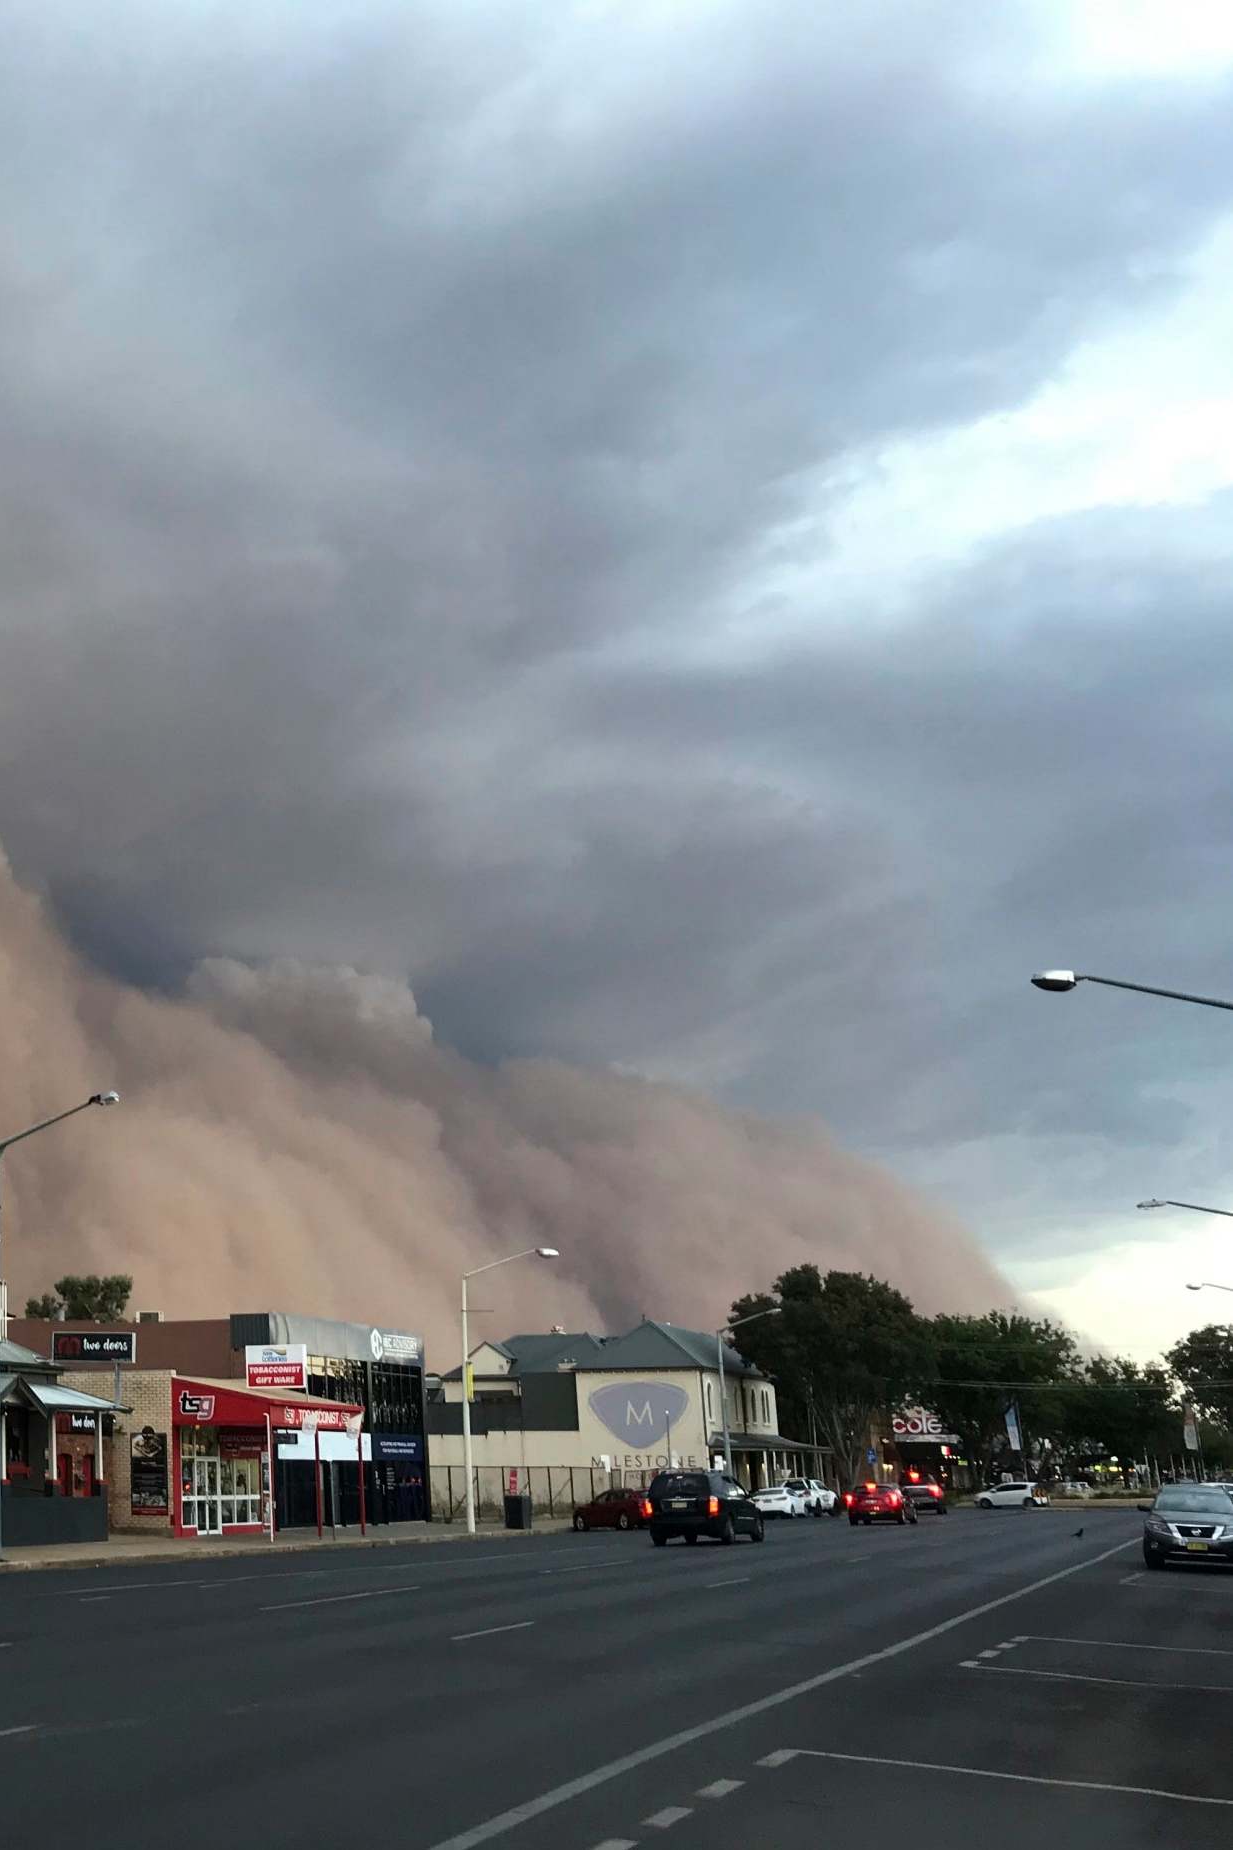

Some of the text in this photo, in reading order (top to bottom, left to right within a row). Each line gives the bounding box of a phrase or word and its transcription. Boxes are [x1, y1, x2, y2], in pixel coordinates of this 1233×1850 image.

[83, 1338, 128, 1351] two doors
[249, 1366, 301, 1374] TOBACCONIST
[273, 1376, 295, 1384] WARE
[179, 1390, 215, 1420] tsg
[626, 1400, 653, 1426] M
[893, 1406, 942, 1433] cole
[592, 1455, 696, 1468] MLESTONE
